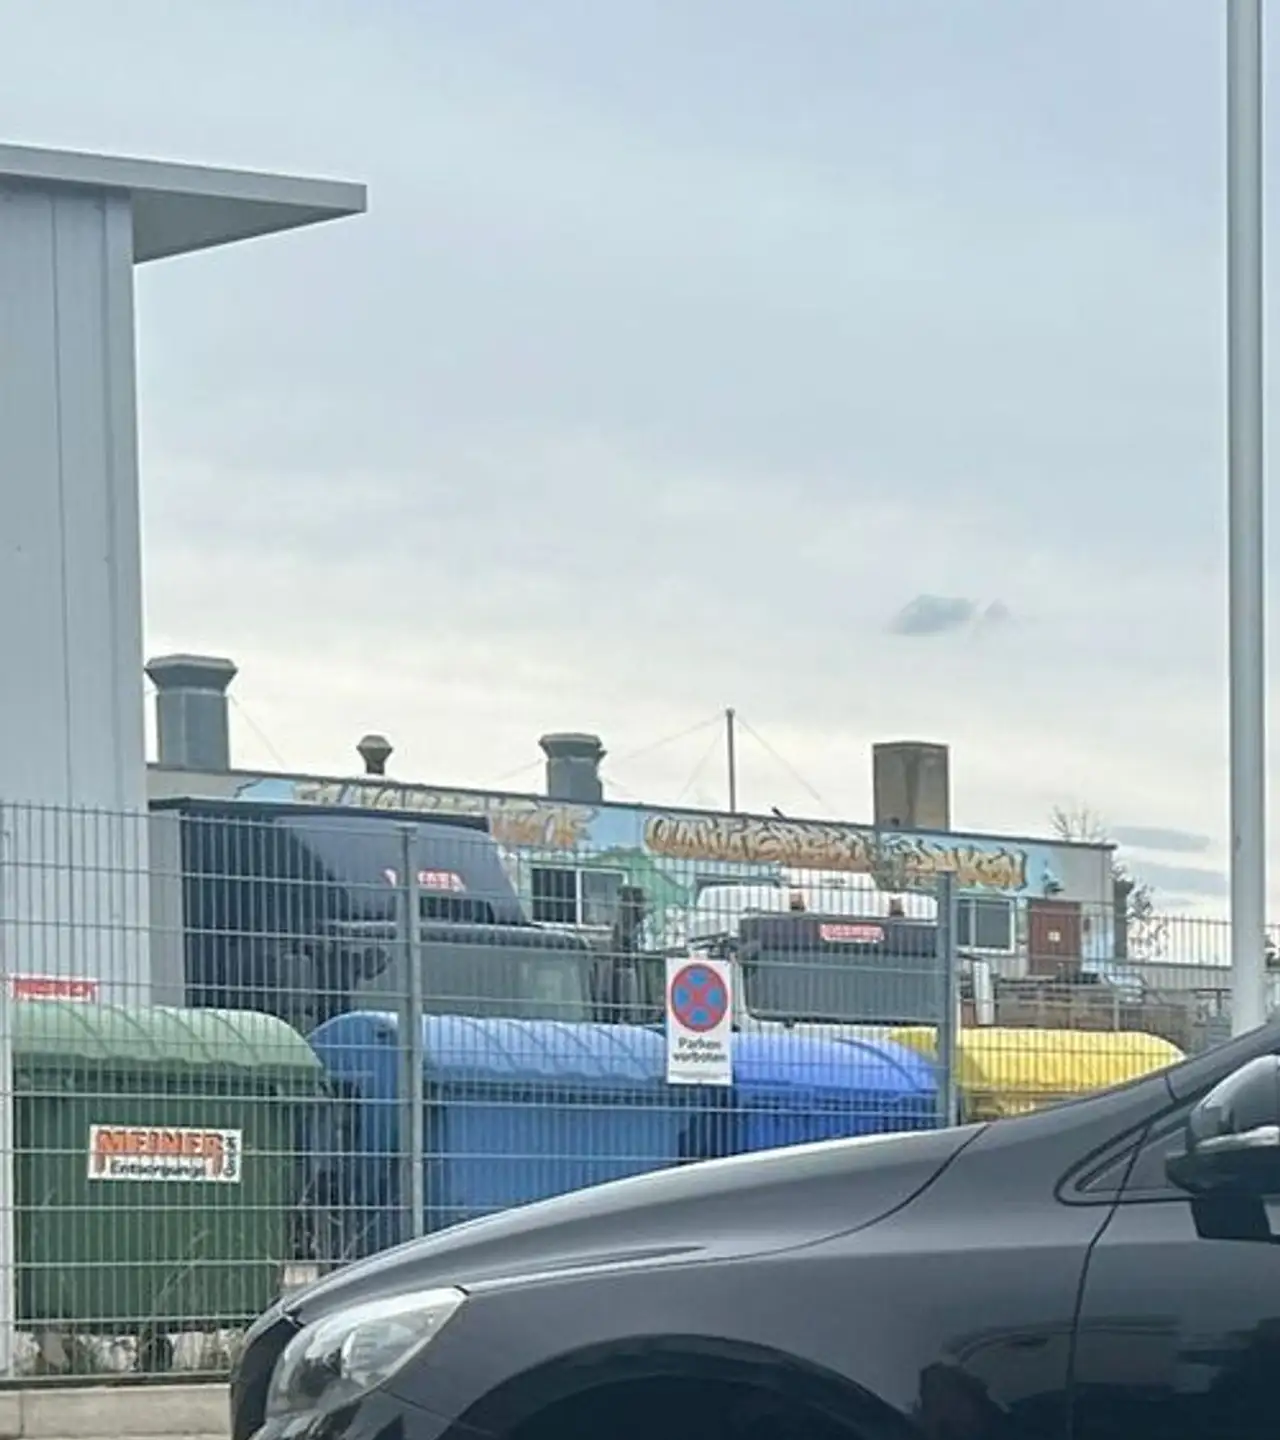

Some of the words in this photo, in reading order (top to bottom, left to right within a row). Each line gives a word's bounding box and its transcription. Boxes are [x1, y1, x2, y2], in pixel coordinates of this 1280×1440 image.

[678, 1037, 722, 1049] Parken
[673, 1051, 727, 1063] verboten
[96, 1131, 224, 1174] MEINER
